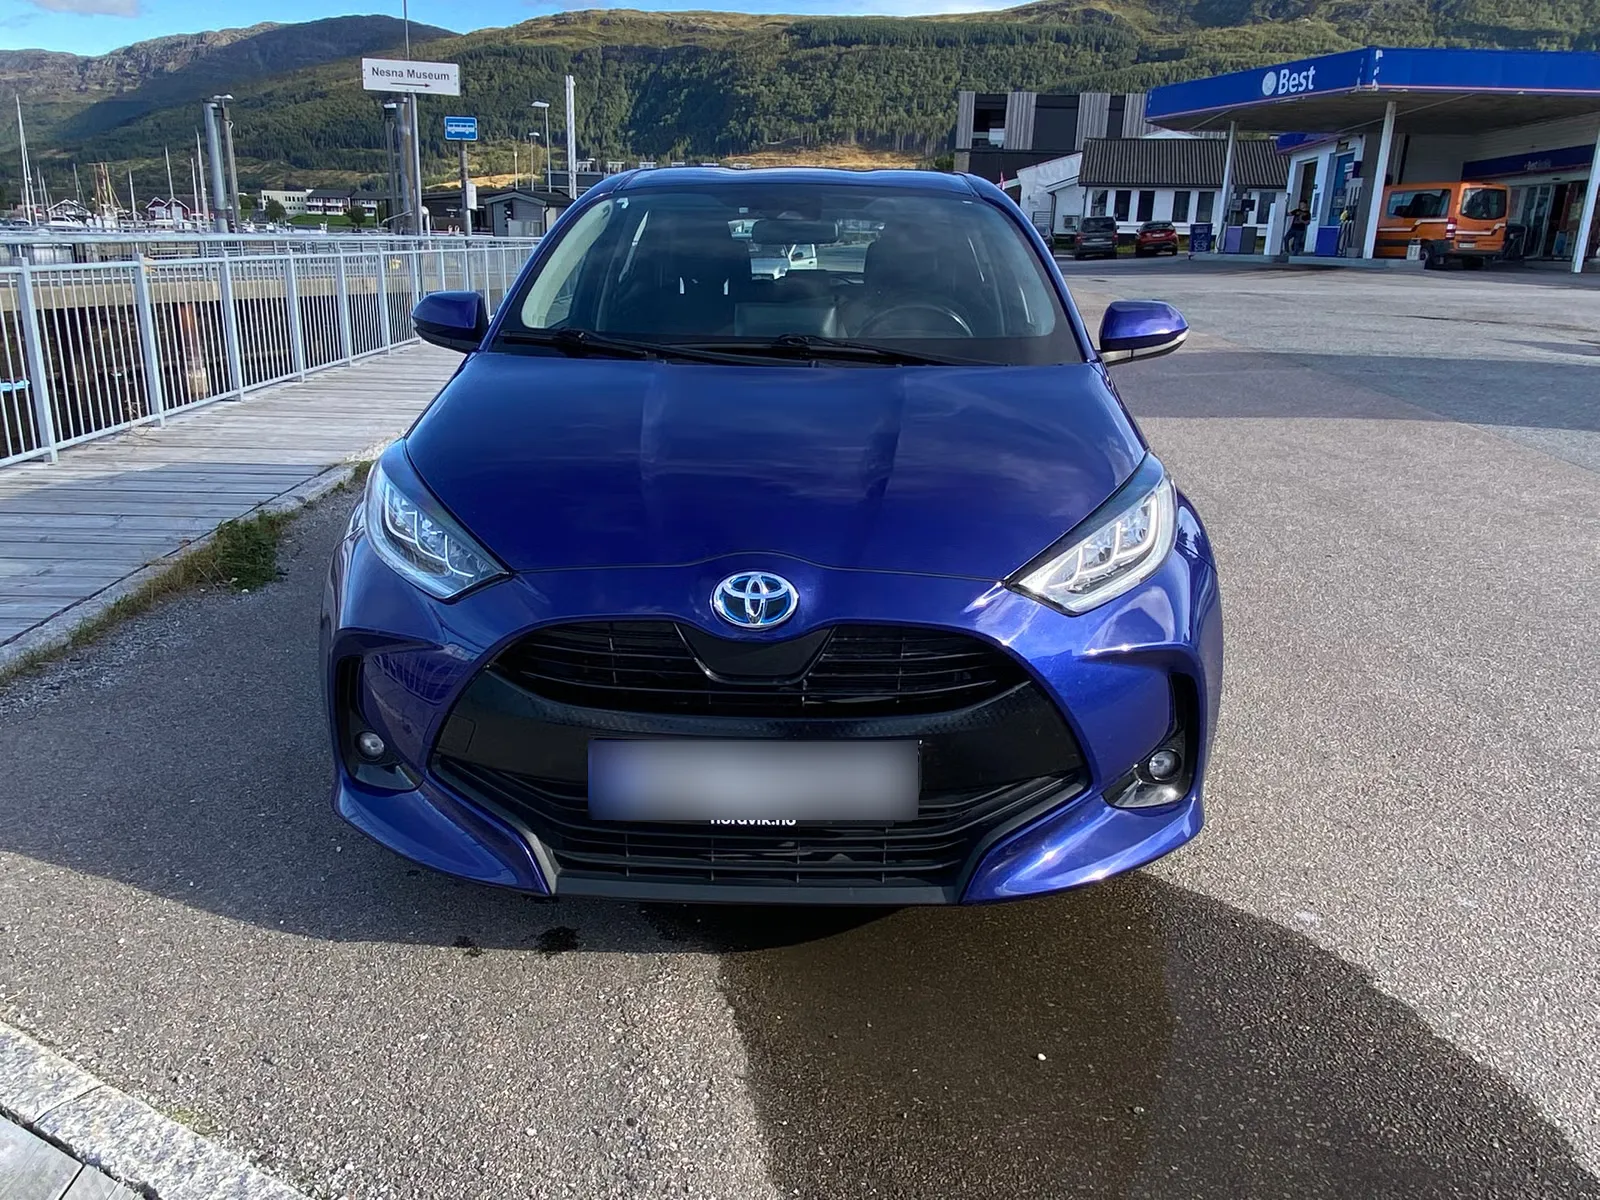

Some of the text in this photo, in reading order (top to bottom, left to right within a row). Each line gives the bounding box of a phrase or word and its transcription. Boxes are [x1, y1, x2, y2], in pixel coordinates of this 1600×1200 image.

[372, 67, 450, 80] Nesna Museum
[1278, 66, 1316, 94] Best
